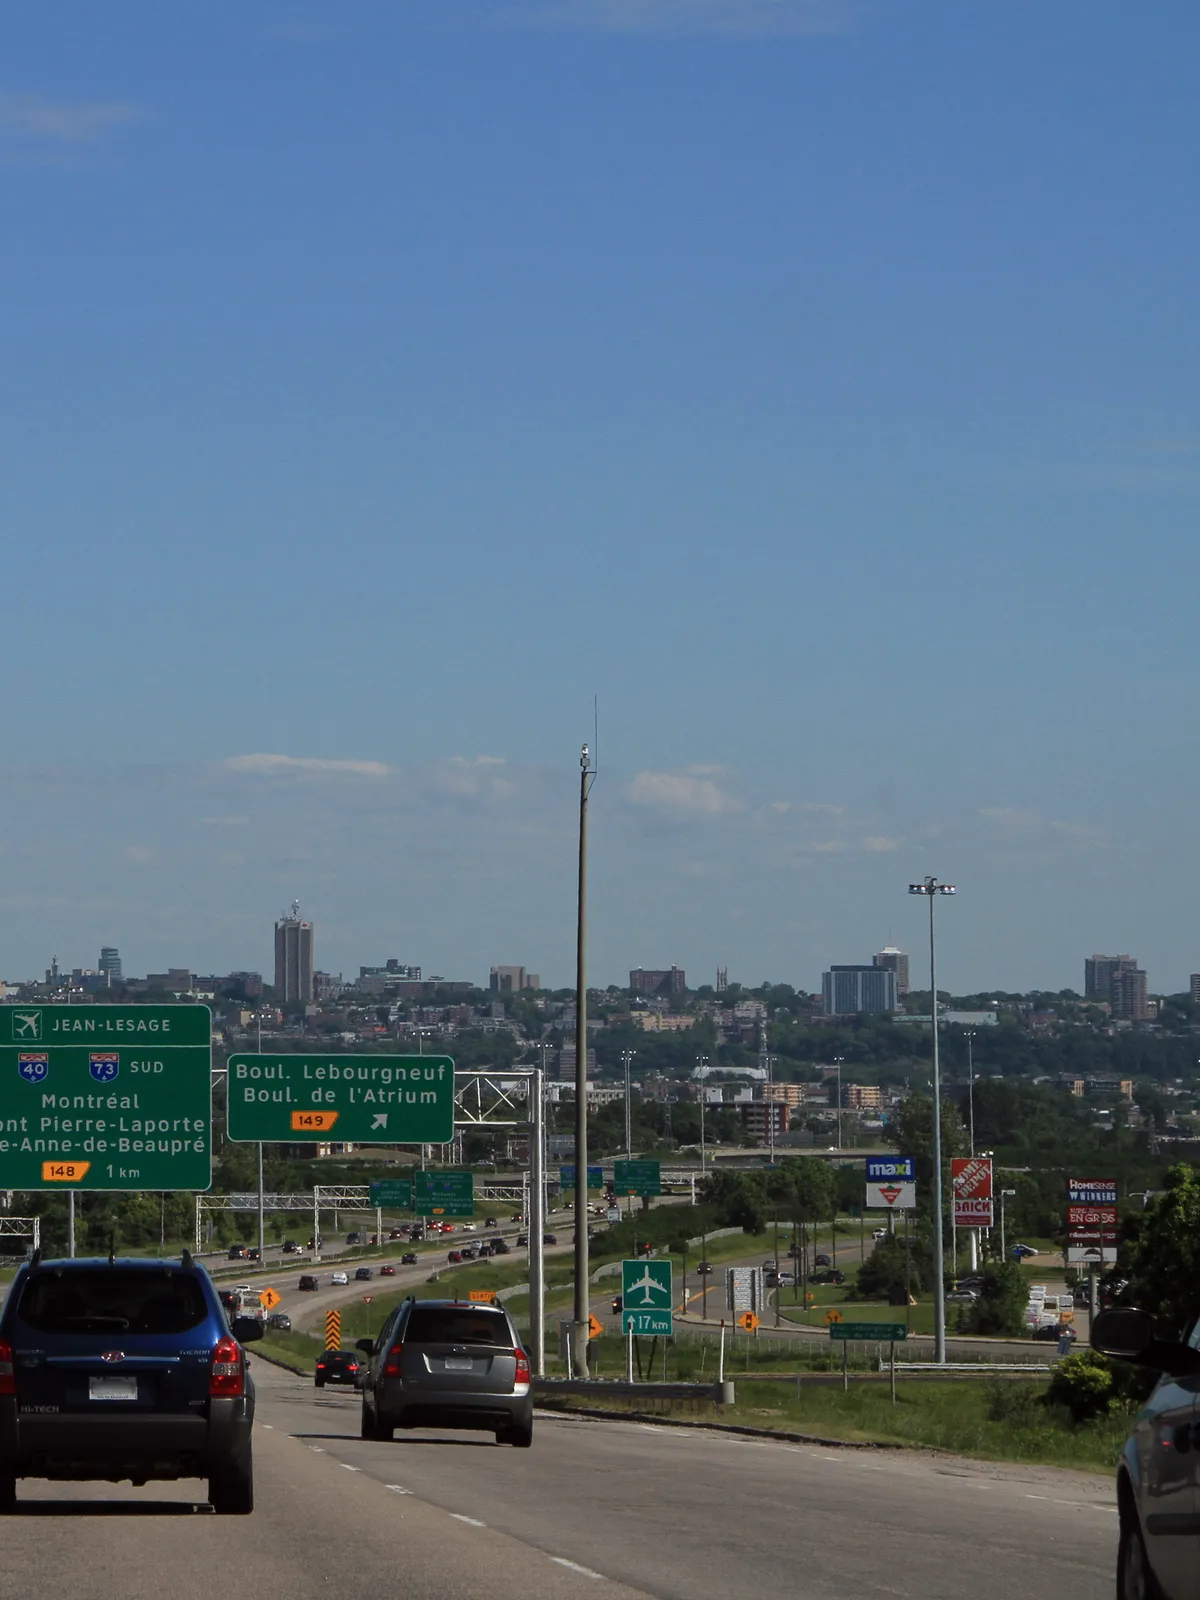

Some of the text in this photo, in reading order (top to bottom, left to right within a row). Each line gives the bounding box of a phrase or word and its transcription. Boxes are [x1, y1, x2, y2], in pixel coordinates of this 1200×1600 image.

[52, 1019, 171, 1032] JEAN-LESAGE
[23, 1061, 164, 1075] 40 73 SUD
[236, 1063, 446, 1084] Boul. Lebourgneuf
[41, 1093, 139, 1109] Montréal
[244, 1087, 438, 1104] Boul. de l'Atrium
[41, 1116, 205, 1136] Pierre-Laporte
[299, 1115, 324, 1126] 149
[50, 1164, 140, 1179] 148 1 km
[869, 1159, 911, 1176] maxi
[954, 1160, 982, 1189] HOME
[958, 1165, 991, 1197] DEPOT
[1080, 1191, 1116, 1201] WINNERS
[954, 1201, 991, 1213] BRICK
[1069, 1213, 1115, 1224] EN GROS
[638, 1315, 669, 1330] 17 km
[20, 1405, 60, 1414] HI-TECH
